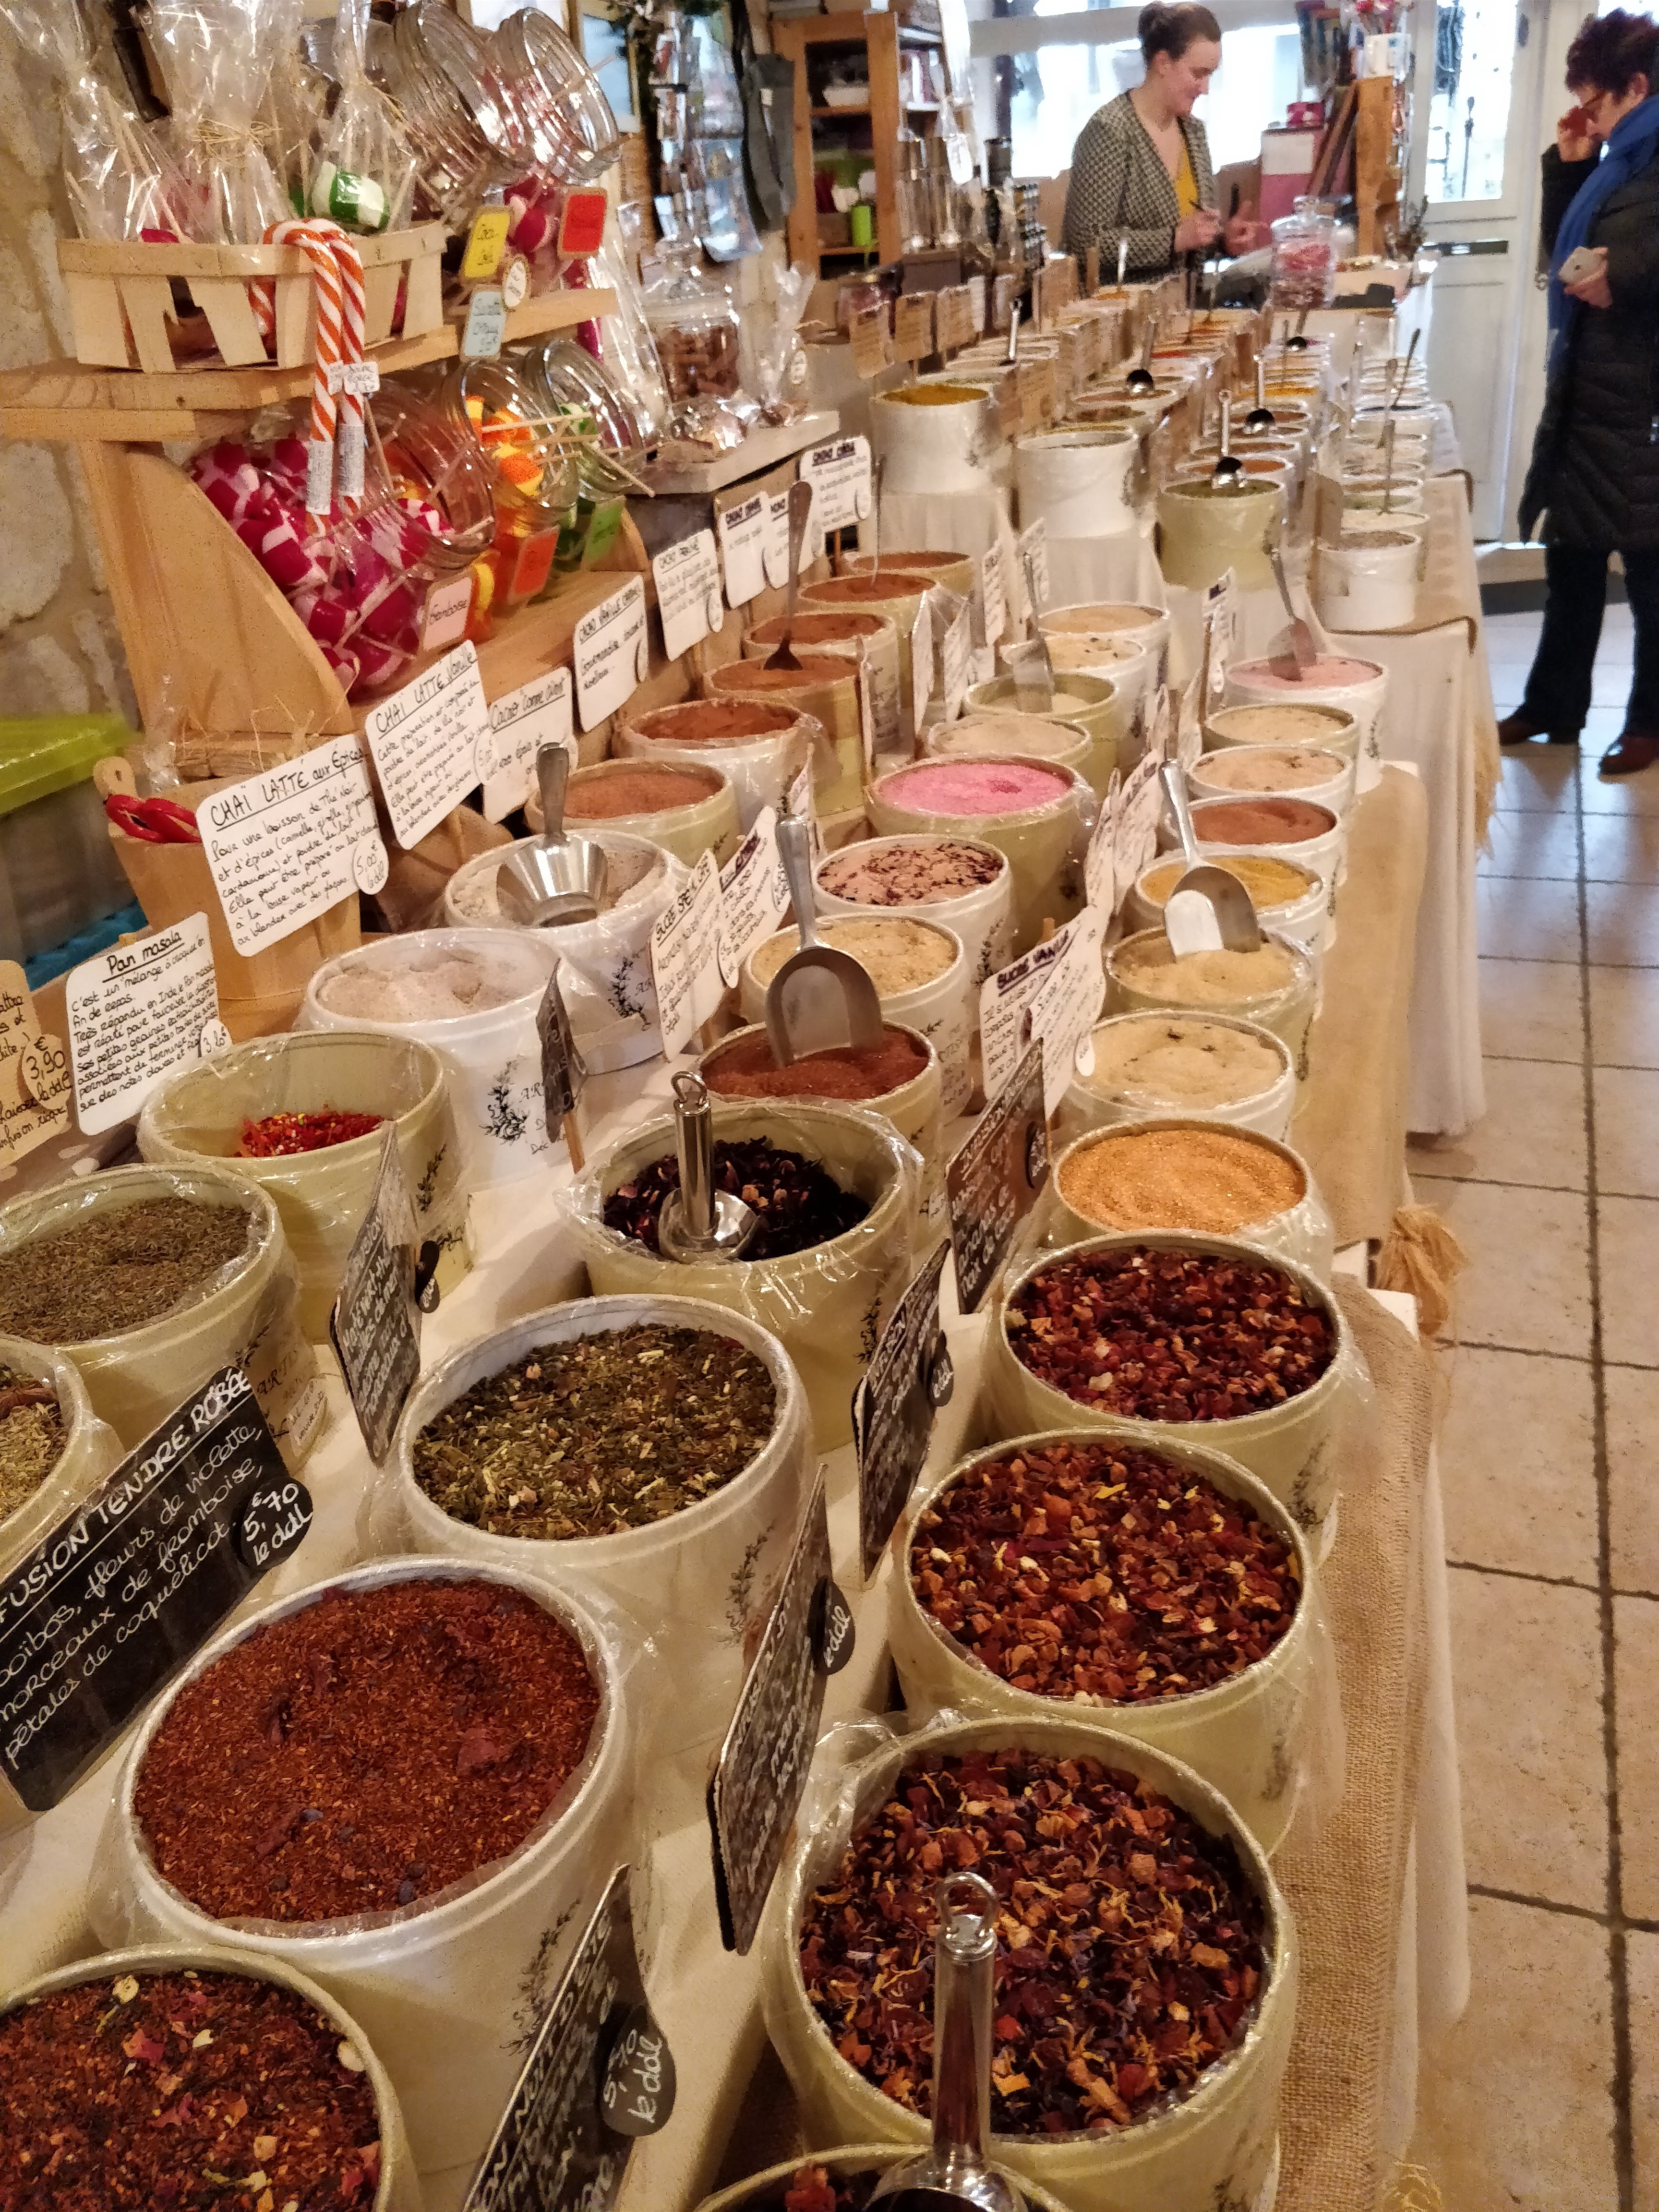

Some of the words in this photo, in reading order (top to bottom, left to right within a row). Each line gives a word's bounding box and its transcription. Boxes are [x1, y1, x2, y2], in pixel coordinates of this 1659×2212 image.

[211, 785, 252, 826] CHAÏ
[263, 813, 305, 834] boisson
[309, 802, 322, 814] de
[218, 866, 231, 882] et
[229, 893, 255, 914] Elle
[236, 917, 244, 929] à
[248, 909, 262, 920] la
[107, 955, 136, 975] Pan
[142, 930, 182, 961] masala
[72, 991, 100, 1011] C'est
[104, 984, 120, 997] un
[73, 1015, 87, 1028] fin
[89, 1007, 101, 1020] de
[74, 1027, 97, 1044] Très
[101, 1007, 145, 1031] répandu
[147, 1000, 157, 1009] en
[34, 1036, 48, 1051] €
[78, 1040, 91, 1057] est
[125, 1048, 145, 1062] aux
[26, 1050, 65, 1080] 3,90
[99, 1089, 117, 1103] des
[93, 1425, 191, 1524] TENDRE
[85, 1527, 155, 1599] fleurs
[161, 1494, 184, 1525] de
[187, 1426, 263, 1493] violette,
[122, 1569, 152, 1602] de
[157, 1457, 262, 1573] framboise,
[5, 1678, 81, 1770] pétales
[83, 1645, 113, 1676] de
[116, 1520, 236, 1644] coquelicot.
